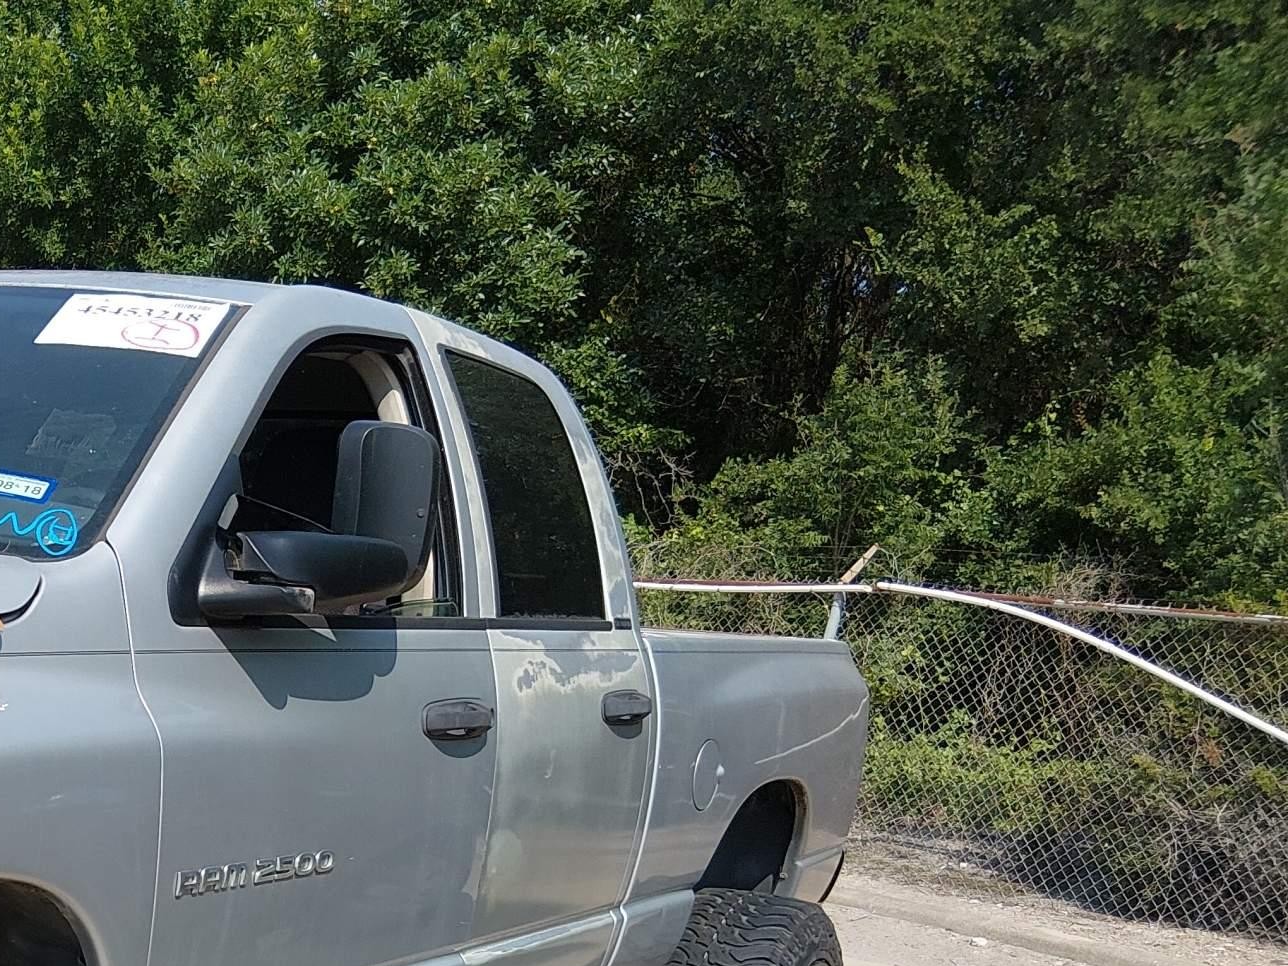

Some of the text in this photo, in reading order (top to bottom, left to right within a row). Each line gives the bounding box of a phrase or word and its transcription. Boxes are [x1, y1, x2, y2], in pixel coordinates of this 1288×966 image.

[77, 304, 204, 323] 45453218
[174, 848, 336, 900] RAM 2500
